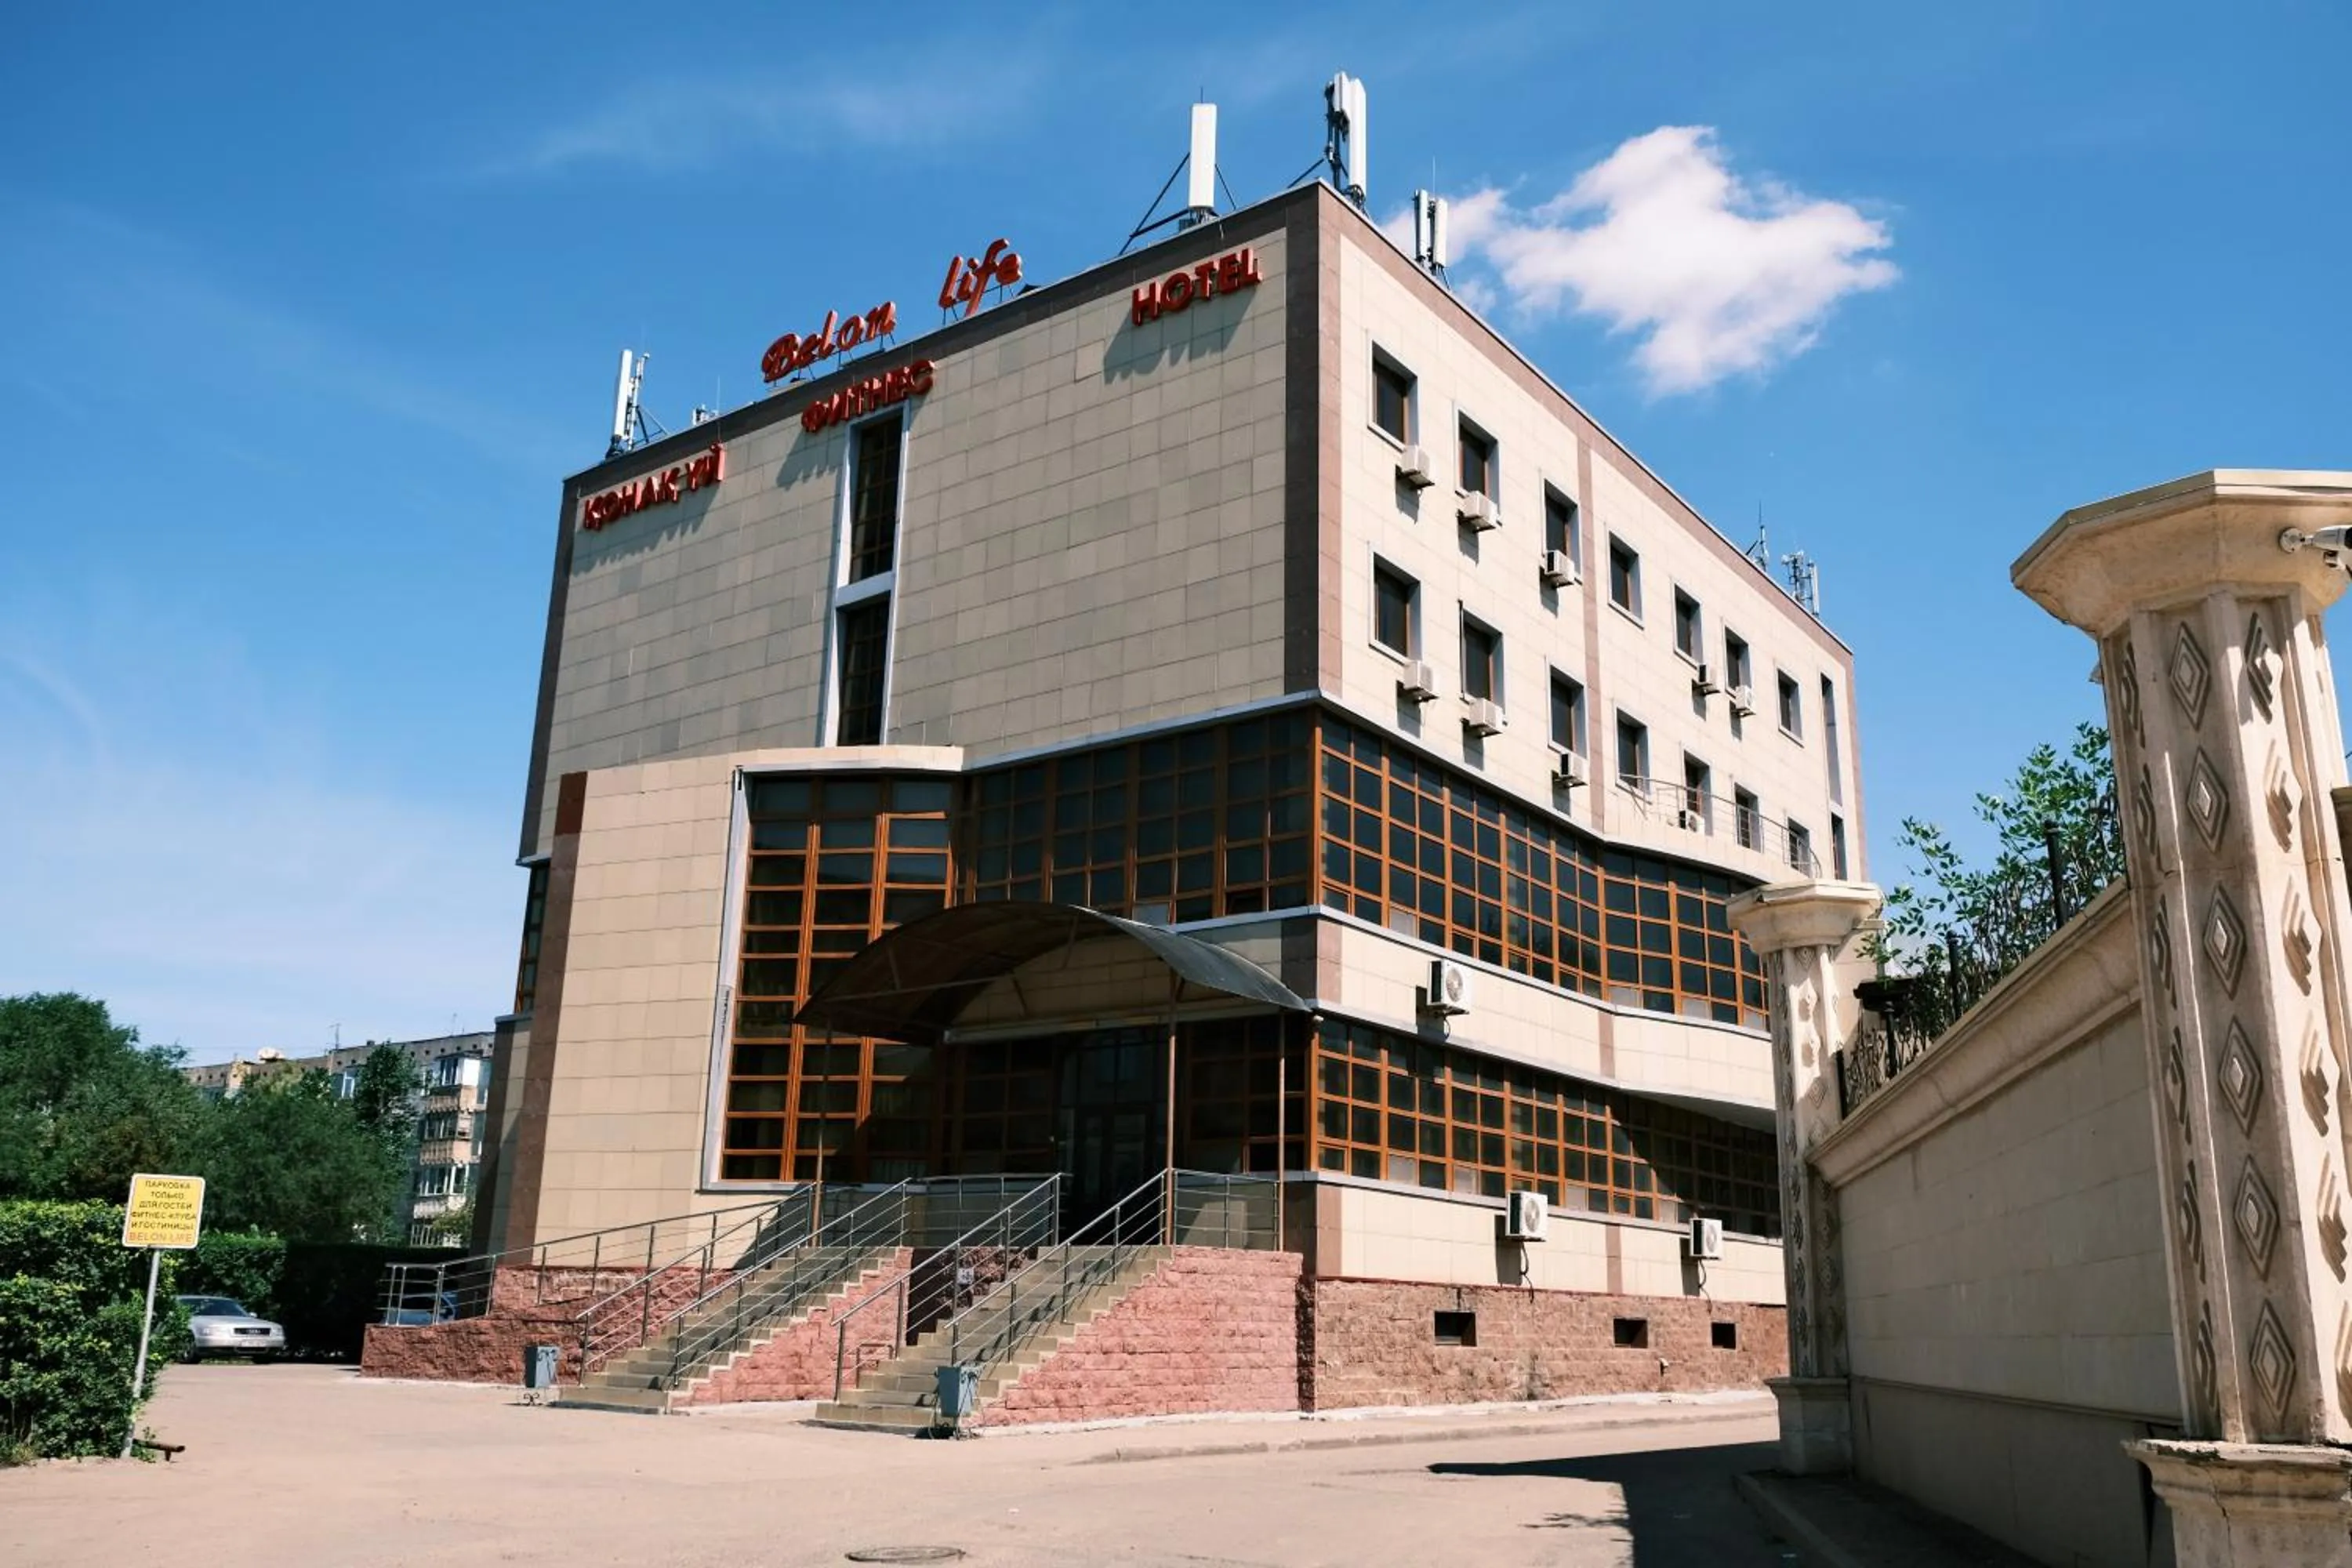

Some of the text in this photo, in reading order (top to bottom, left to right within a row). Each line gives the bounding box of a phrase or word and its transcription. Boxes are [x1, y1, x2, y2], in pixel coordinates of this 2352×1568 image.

[1131, 247, 1263, 327] HOTEL
[762, 300, 896, 383] Belon
[801, 359, 937, 433] ФИТНЕС
